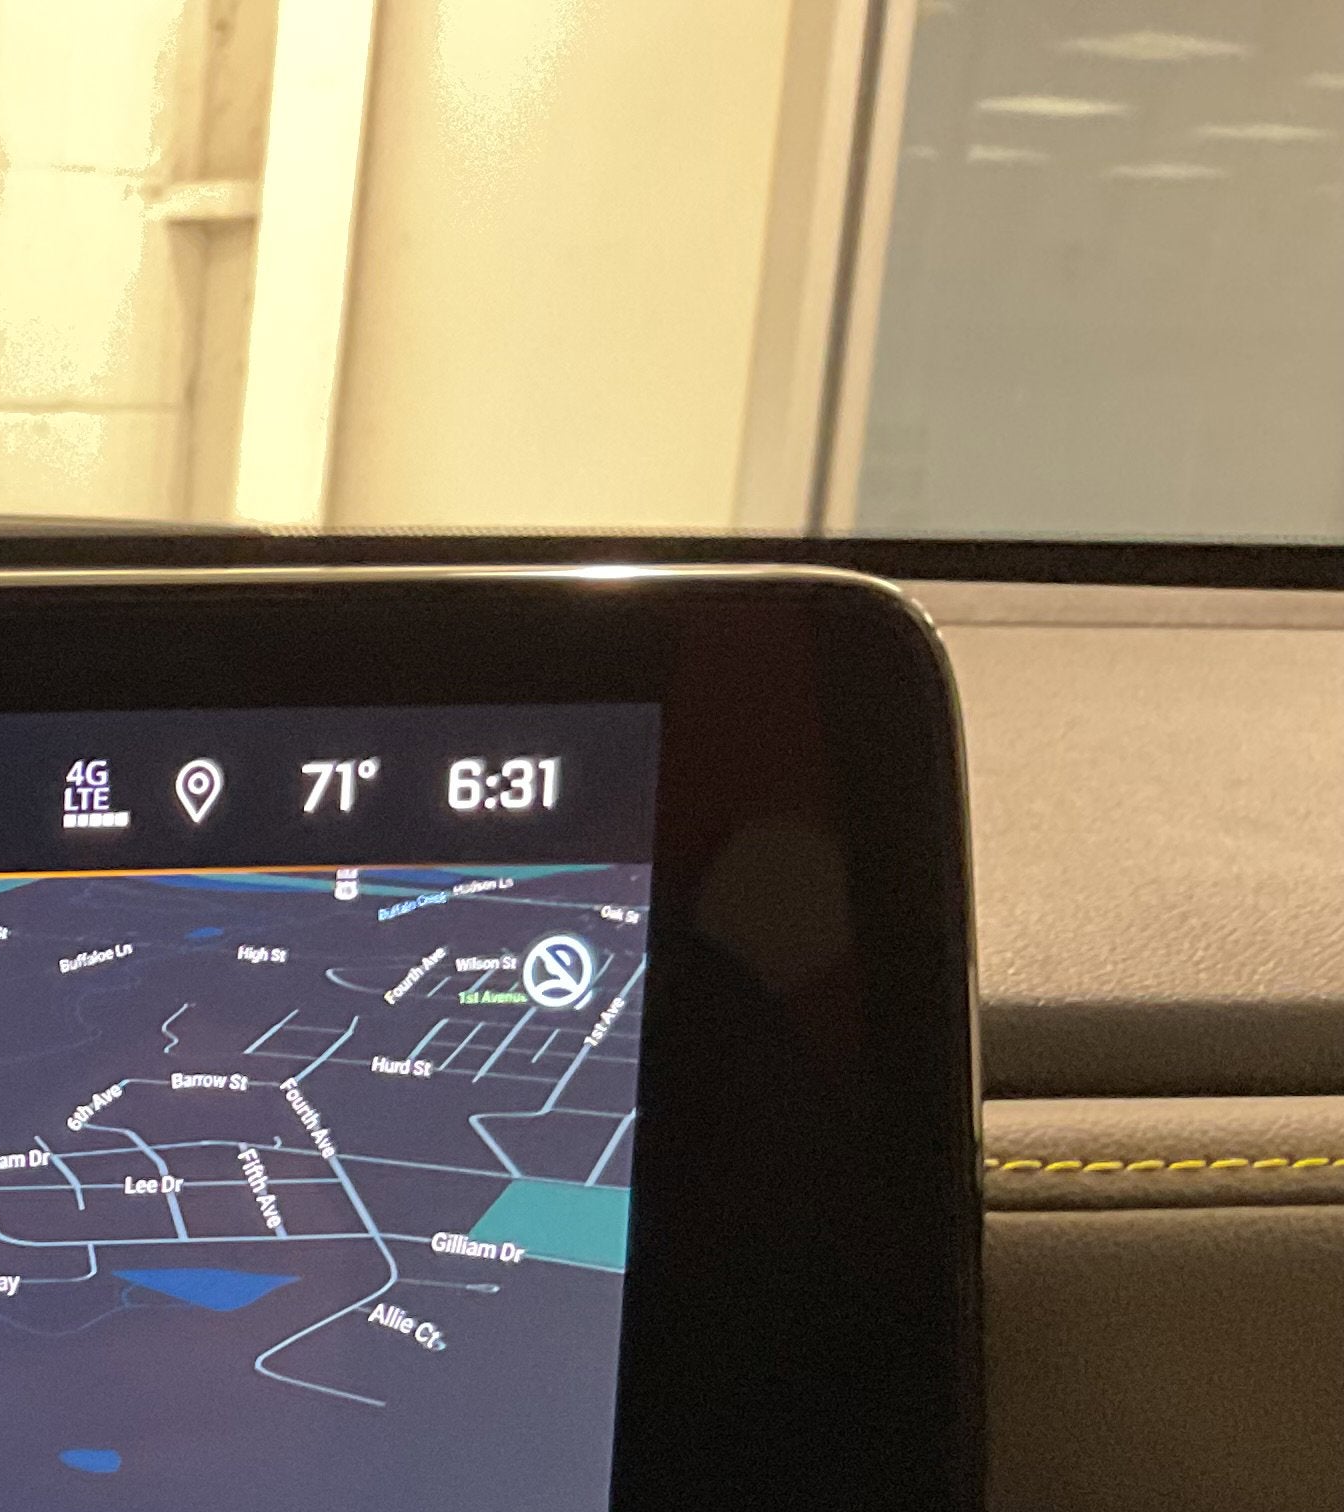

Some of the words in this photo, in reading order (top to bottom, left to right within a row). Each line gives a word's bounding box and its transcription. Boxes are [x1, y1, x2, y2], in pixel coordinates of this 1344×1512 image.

[66, 760, 109, 786] 4G
[302, 759, 380, 813] 71°
[448, 758, 560, 810] 6:31
[64, 787, 110, 811] LTE
[237, 944, 266, 962] High
[269, 947, 286, 963] St
[456, 957, 499, 971] Wilson
[502, 957, 517, 970] St
[384, 966, 423, 1005] Fourth
[422, 946, 447, 971] Ave
[600, 997, 624, 1026] Ave
[372, 1056, 408, 1074] Hurd
[412, 1060, 431, 1077] St
[171, 1073, 226, 1091] Barrow
[229, 1074, 247, 1091] St
[67, 1105, 92, 1133] 6th
[90, 1083, 123, 1112] Ave
[279, 1077, 320, 1130] Fourth
[310, 1127, 335, 1159] Ave
[27, 1149, 50, 1168] Dr
[124, 1176, 157, 1194] Lee
[161, 1176, 183, 1193] Dr
[238, 1147, 267, 1192] Fifth
[255, 1189, 281, 1229] Ave
[431, 1231, 497, 1260] Gilliam
[500, 1242, 525, 1263] Dr
[368, 1303, 414, 1334] Allie
[414, 1319, 441, 1348] Ct
